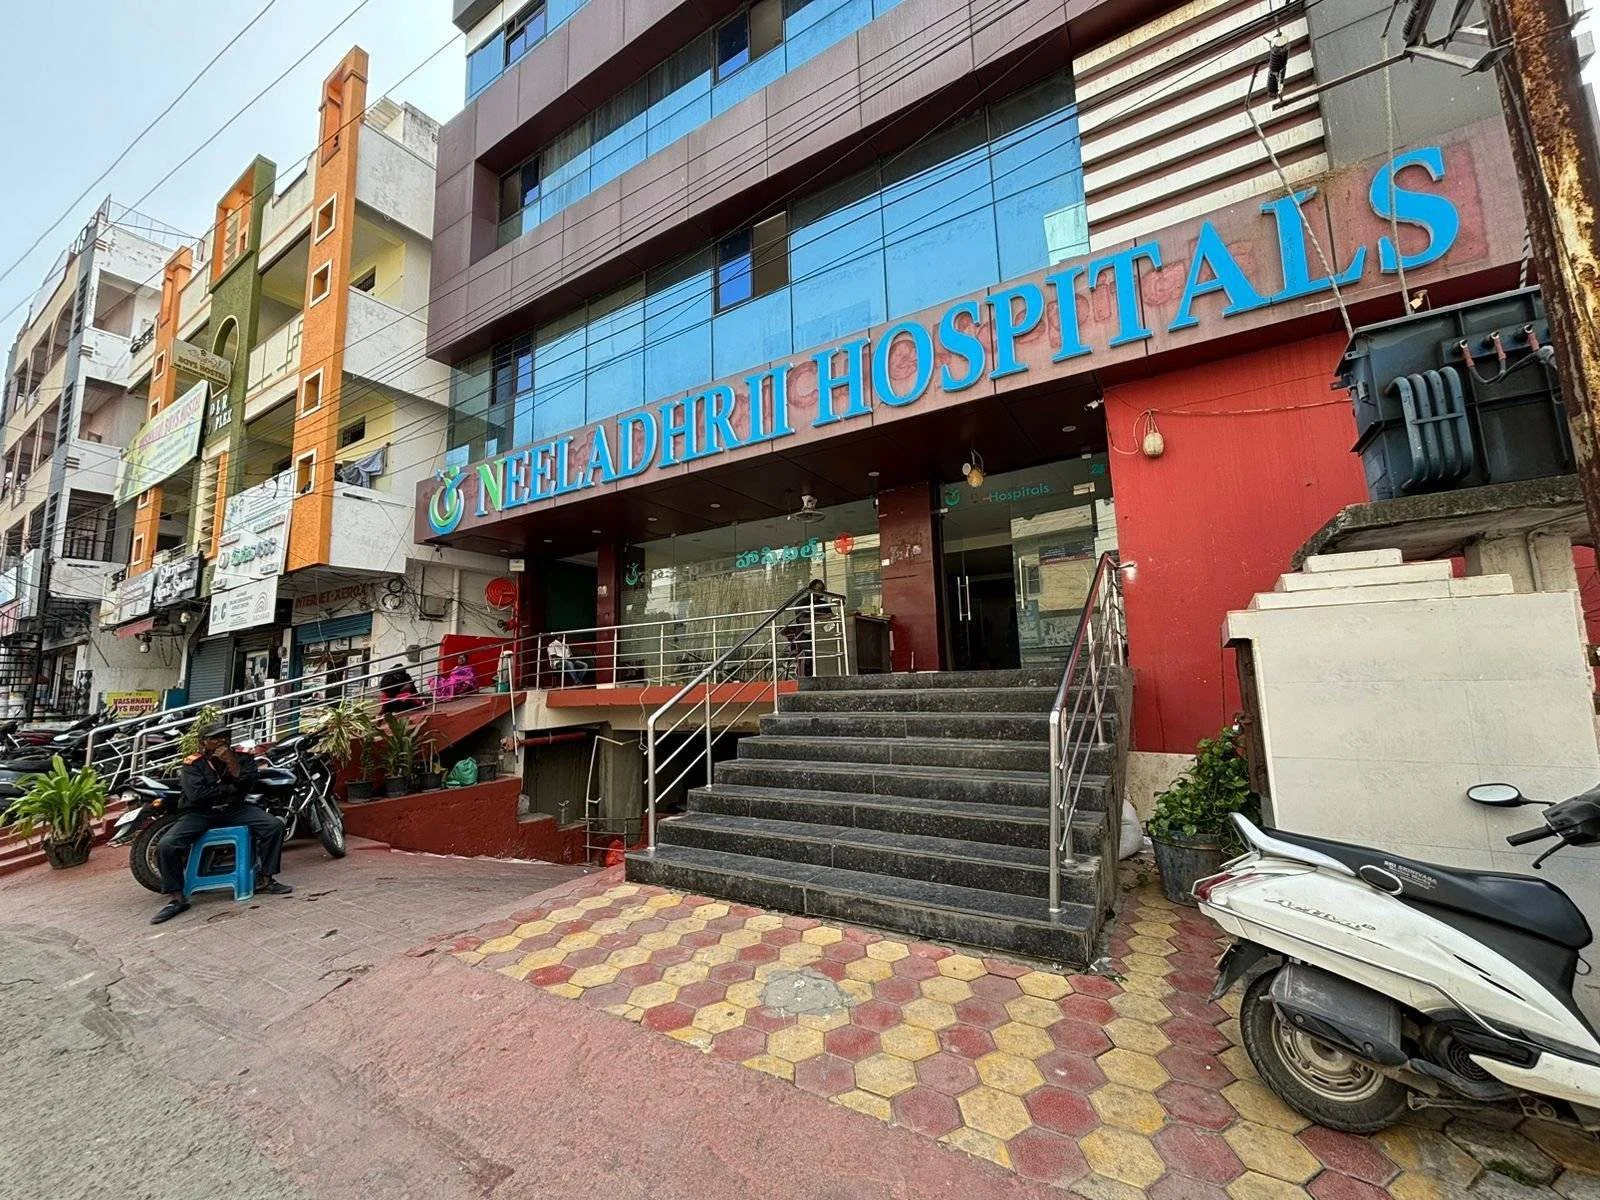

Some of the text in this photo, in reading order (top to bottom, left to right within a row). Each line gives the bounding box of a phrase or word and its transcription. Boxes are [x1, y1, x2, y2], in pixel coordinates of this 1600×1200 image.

[475, 146, 1460, 518] NEELADHRII HOSPITALS
[988, 483, 1051, 503] Hospitals
[112, 696, 153, 706] VAISHNAVI
